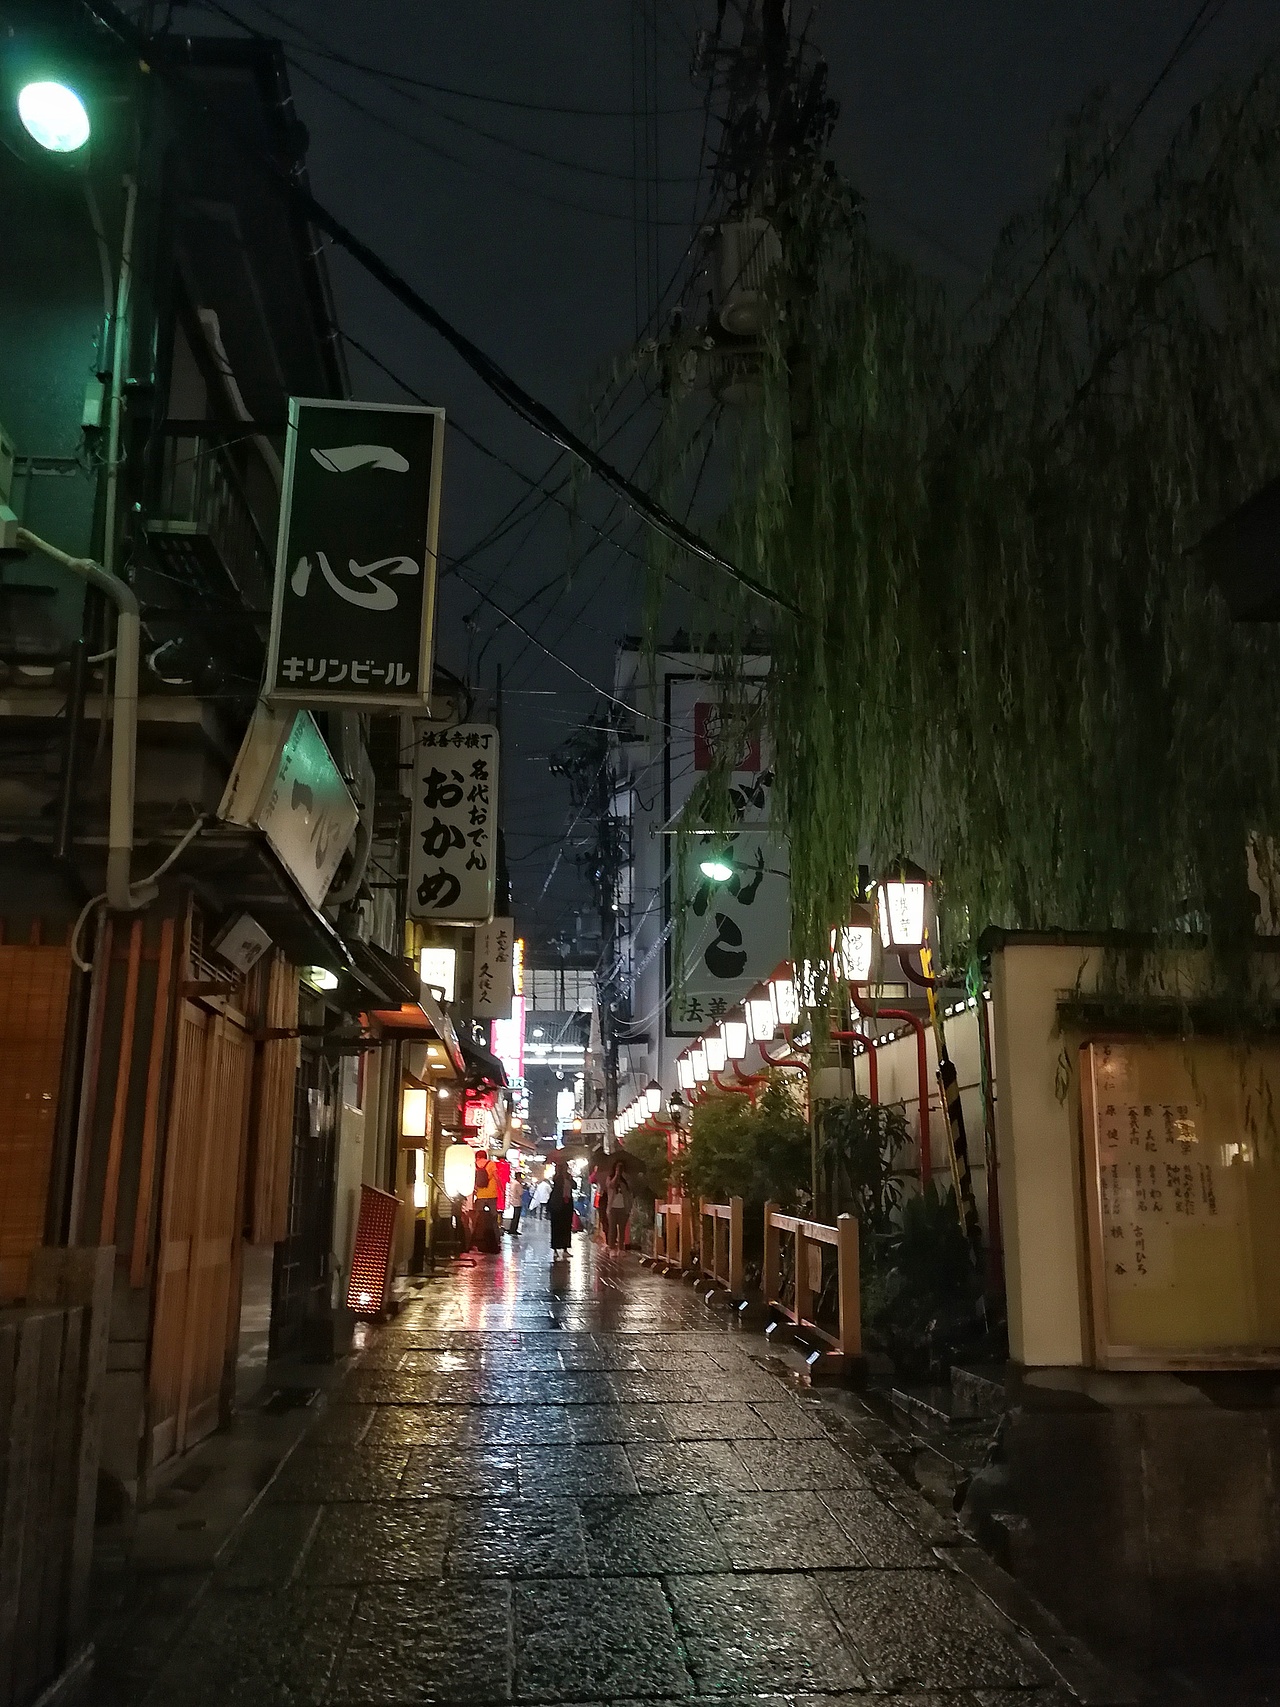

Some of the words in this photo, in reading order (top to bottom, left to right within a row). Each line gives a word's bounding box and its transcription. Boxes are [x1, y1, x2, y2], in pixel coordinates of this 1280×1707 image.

[291, 444, 420, 611] 一心
[282, 656, 411, 687] キリンビール
[422, 731, 493, 749] 法善寺横丁
[416, 767, 466, 909] おかめ
[466, 759, 489, 871] 名代おでん
